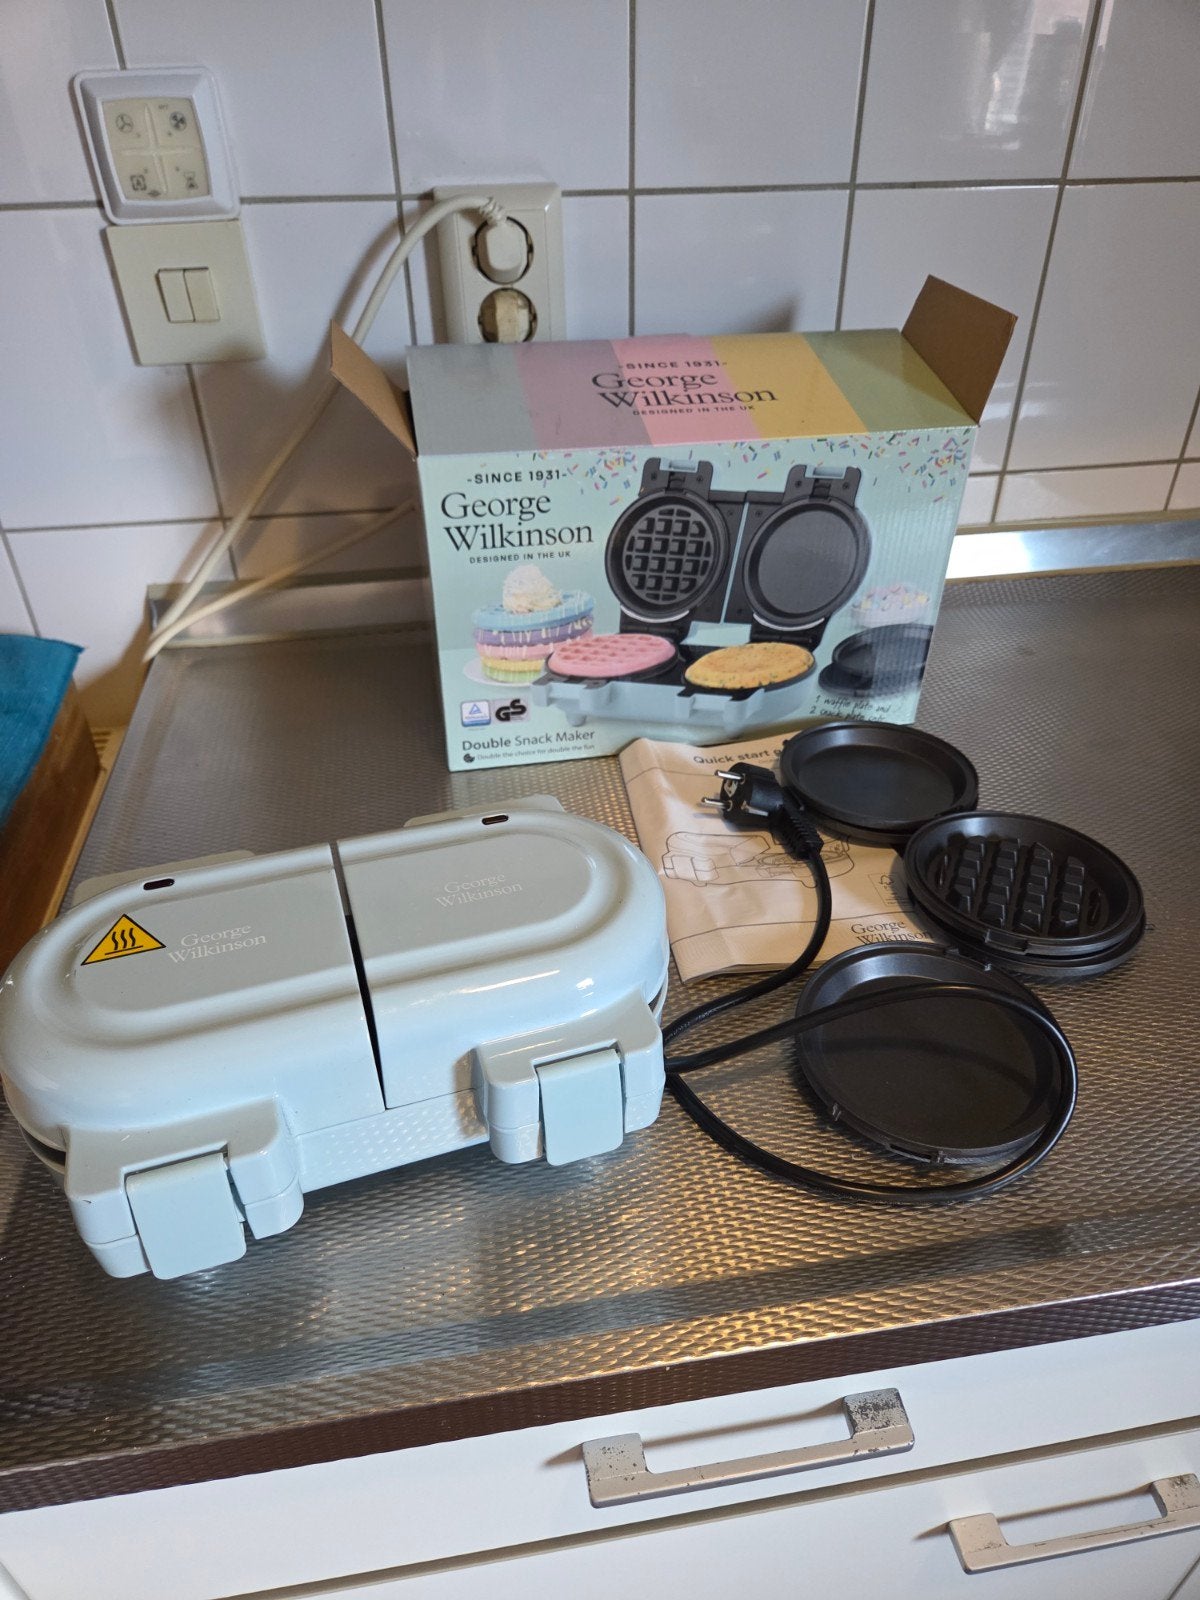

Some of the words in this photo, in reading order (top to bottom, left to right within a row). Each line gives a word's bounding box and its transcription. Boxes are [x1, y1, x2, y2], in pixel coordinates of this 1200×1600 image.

[592, 373, 718, 391] George
[598, 389, 778, 408] Wilkinson
[632, 408, 694, 416] DESIGNED
[441, 492, 551, 521] George
[443, 522, 594, 551] Wilkinson
[469, 554, 520, 564] DESIGNED
[495, 699, 527, 721] GS
[809, 705, 817, 714] 2
[462, 738, 511, 751] Double
[515, 733, 553, 746] Snack
[556, 730, 595, 742] Maker
[515, 749, 536, 757] choice
[547, 746, 571, 754] double
[693, 754, 734, 764] Quick
[737, 750, 770, 760] start
[444, 874, 506, 893] George
[434, 883, 523, 907] Wilkinson
[180, 925, 252, 947] George
[851, 921, 906, 934] George
[856, 932, 933, 945] Wilkinson
[168, 935, 267, 963] Wilkinson
